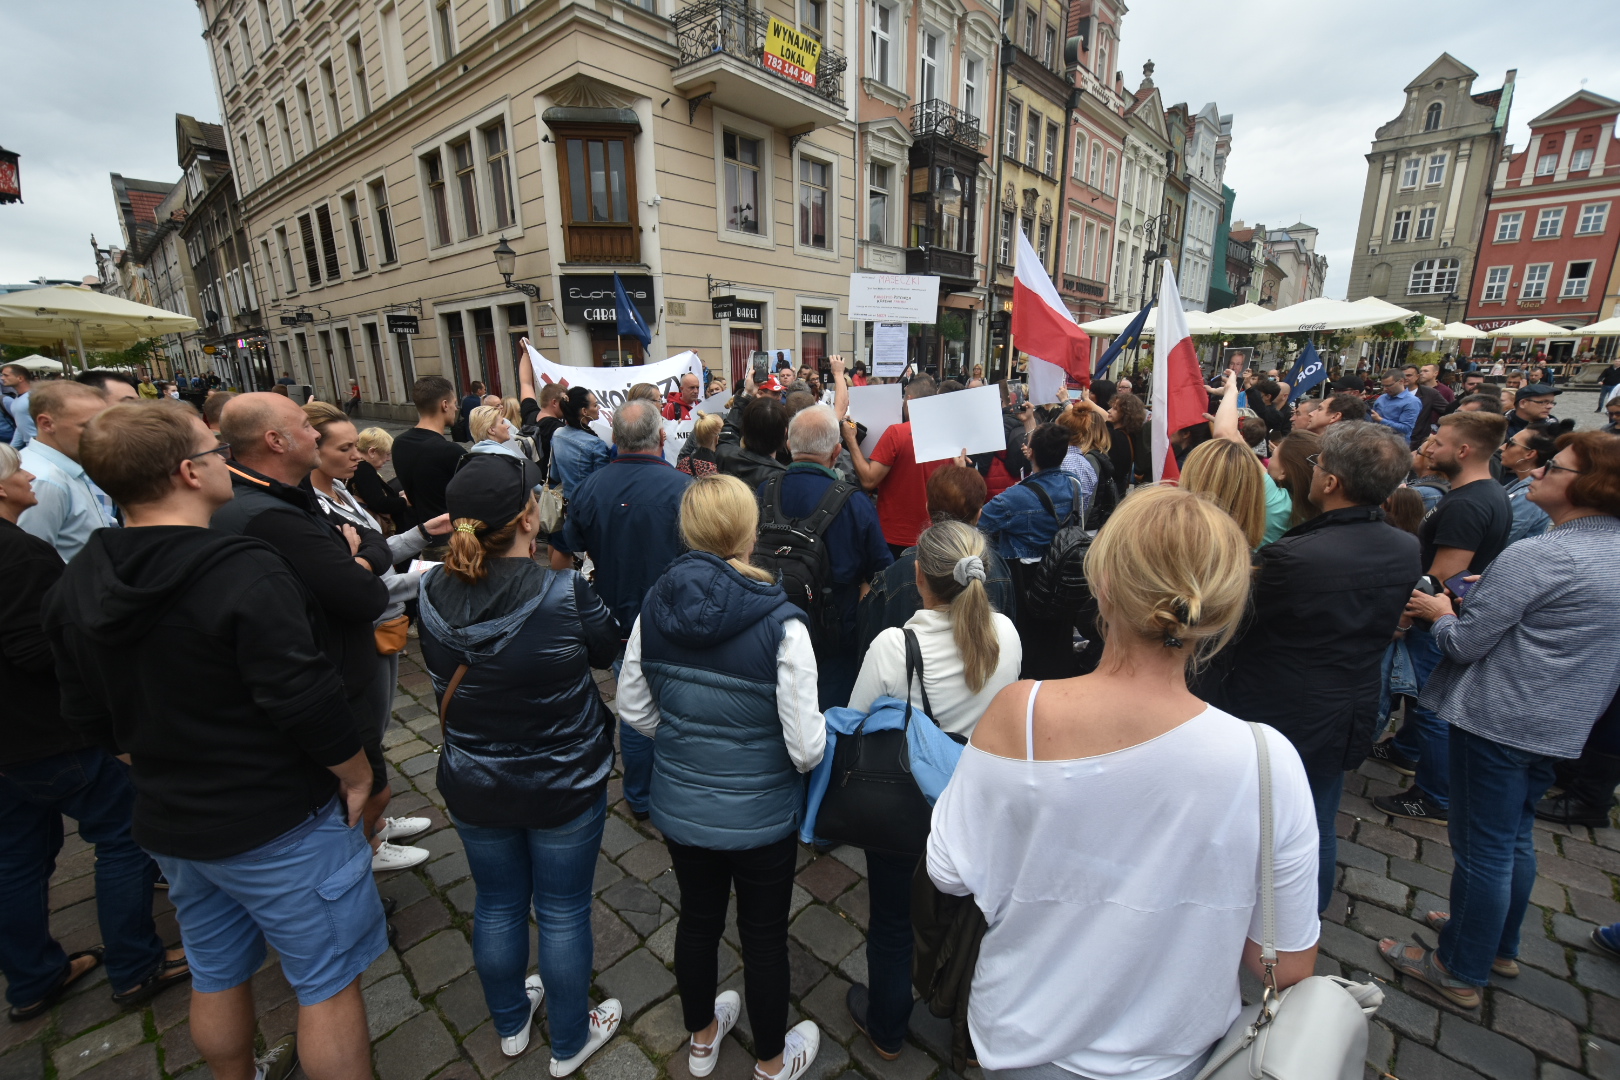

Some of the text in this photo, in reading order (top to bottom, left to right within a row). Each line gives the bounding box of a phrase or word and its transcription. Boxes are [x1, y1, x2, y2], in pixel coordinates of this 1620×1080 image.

[767, 54, 782, 70] 782
[784, 62, 798, 78] 144
[780, 45, 805, 67] LOKAL
